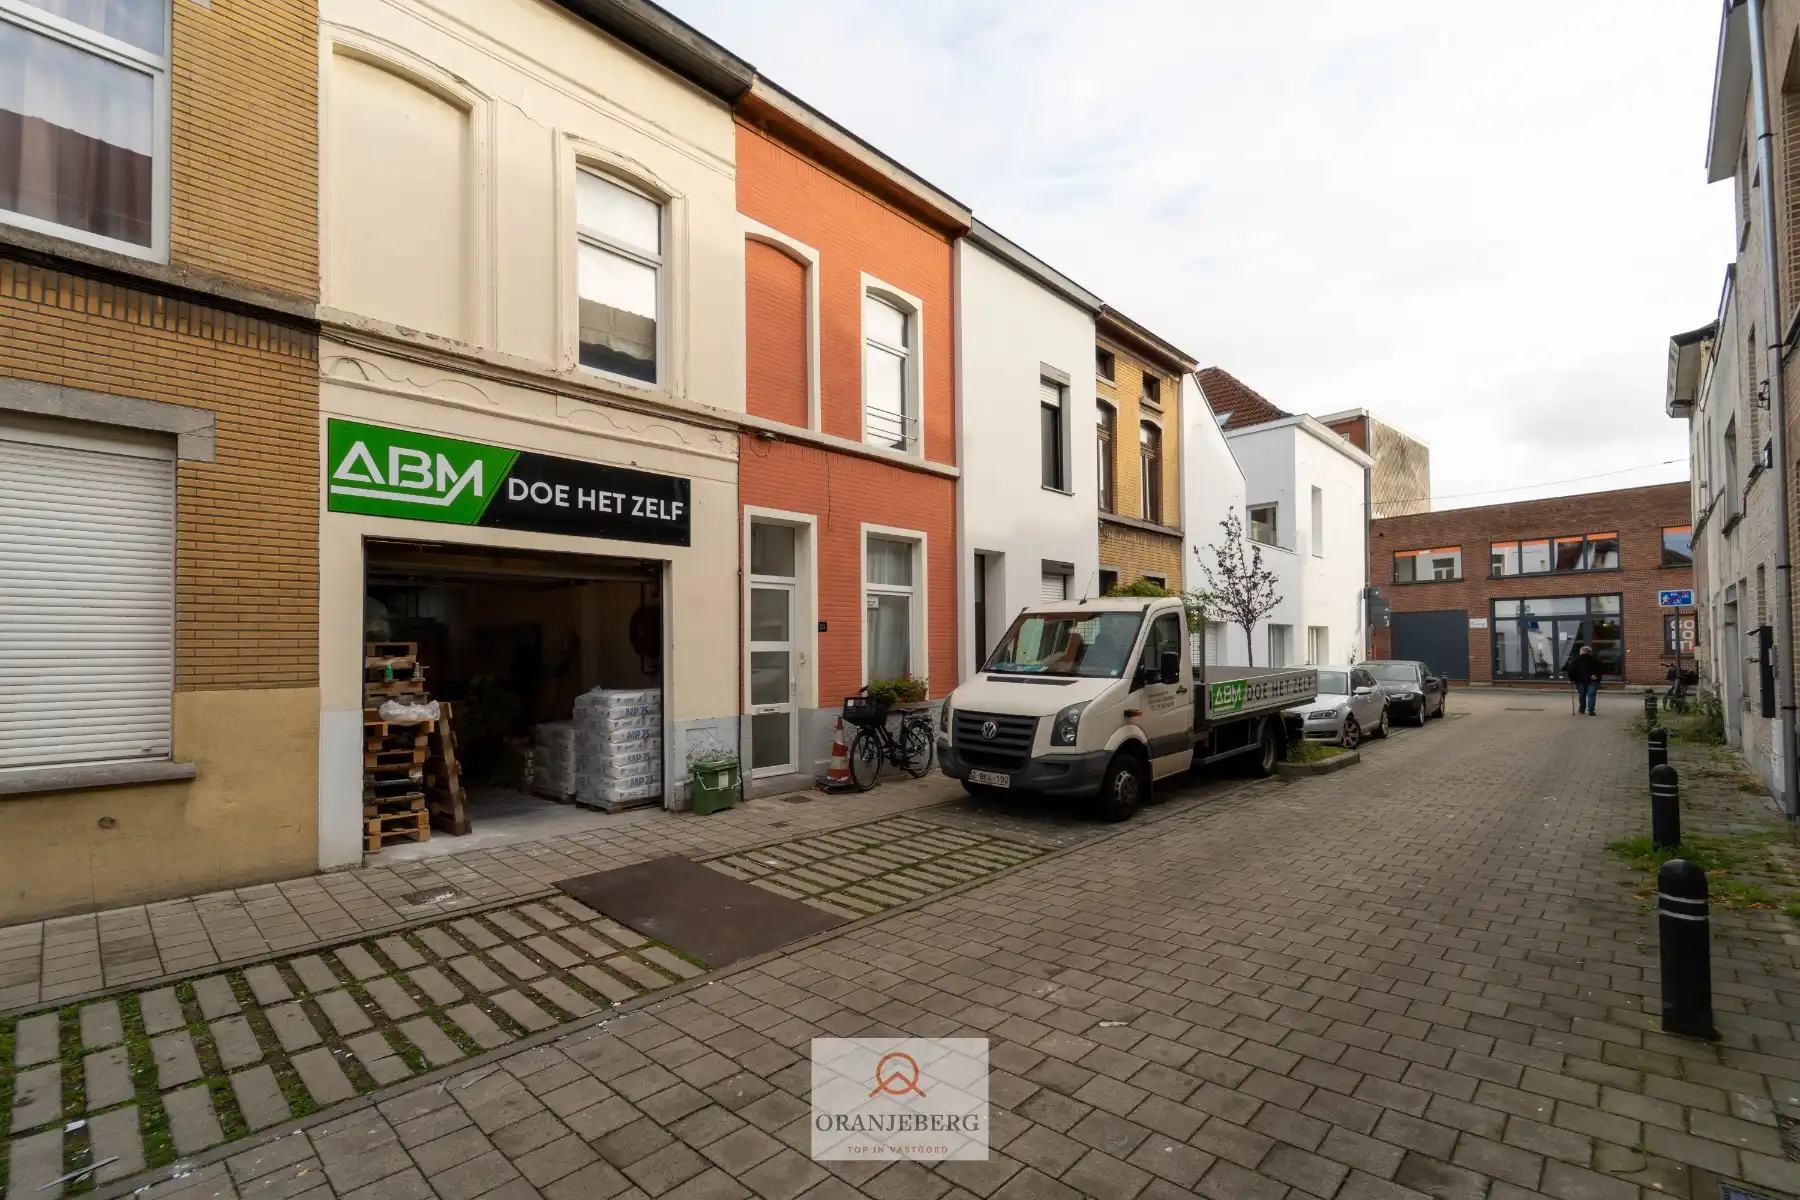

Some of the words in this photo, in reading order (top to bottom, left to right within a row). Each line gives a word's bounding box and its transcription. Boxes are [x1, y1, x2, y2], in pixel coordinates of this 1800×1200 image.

[331, 440, 483, 503] ABM
[508, 477, 570, 508] DOE
[577, 487, 627, 515] HET
[631, 495, 684, 522] ZELF
[1214, 684, 1242, 706] ABM
[1246, 682, 1268, 702] DOE
[1271, 680, 1290, 697] HET
[1293, 675, 1313, 694] ZELF
[625, 706, 639, 717] MP
[640, 706, 649, 716] 75
[626, 730, 640, 741] MP
[627, 754, 641, 764] MP
[630, 776, 644, 787] MP
